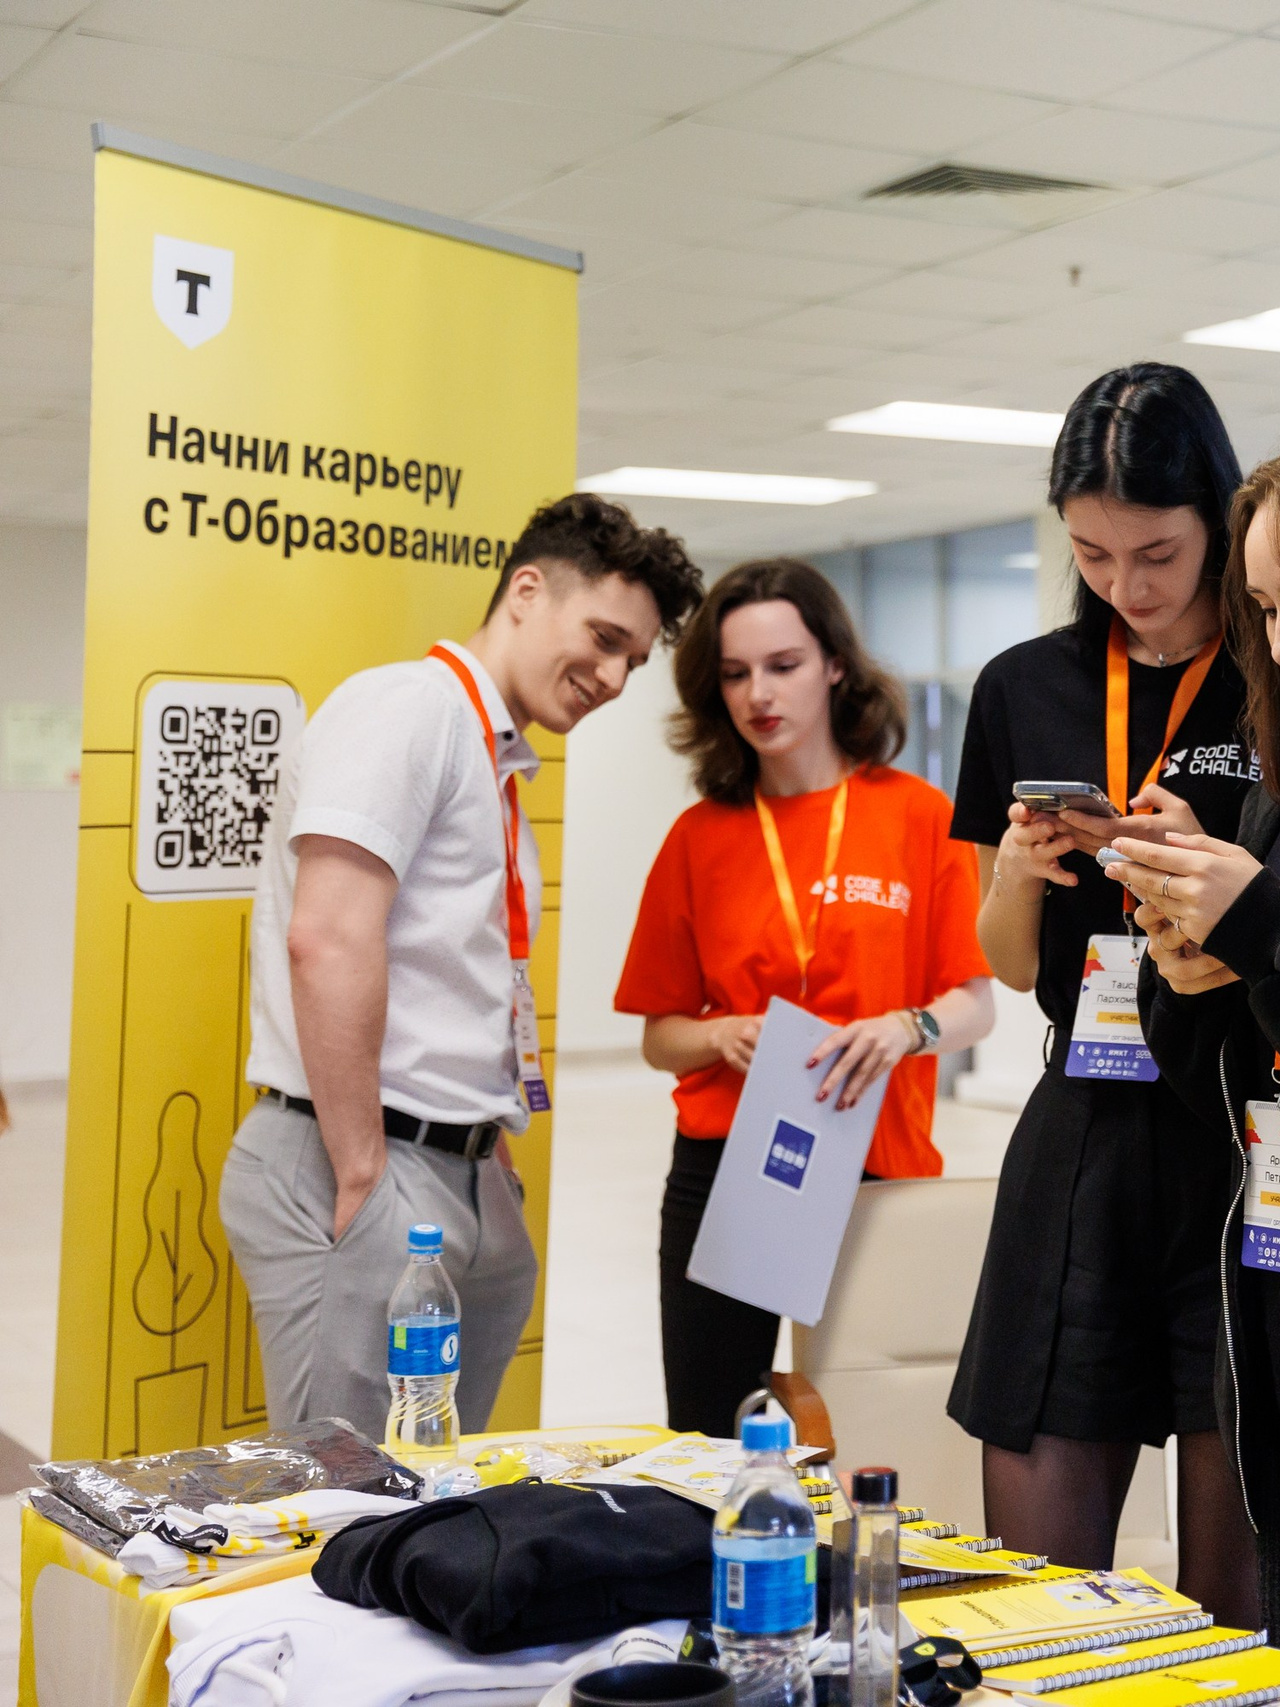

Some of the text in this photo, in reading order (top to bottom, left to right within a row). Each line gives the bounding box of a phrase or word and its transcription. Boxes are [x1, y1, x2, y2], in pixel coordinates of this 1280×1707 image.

[147, 412, 463, 510] Начни карьеру
[144, 497, 169, 533] с
[1192, 744, 1241, 760] CODE
[1189, 760, 1263, 782] CHALLE
[1096, 994, 1138, 1004] Пархоме
